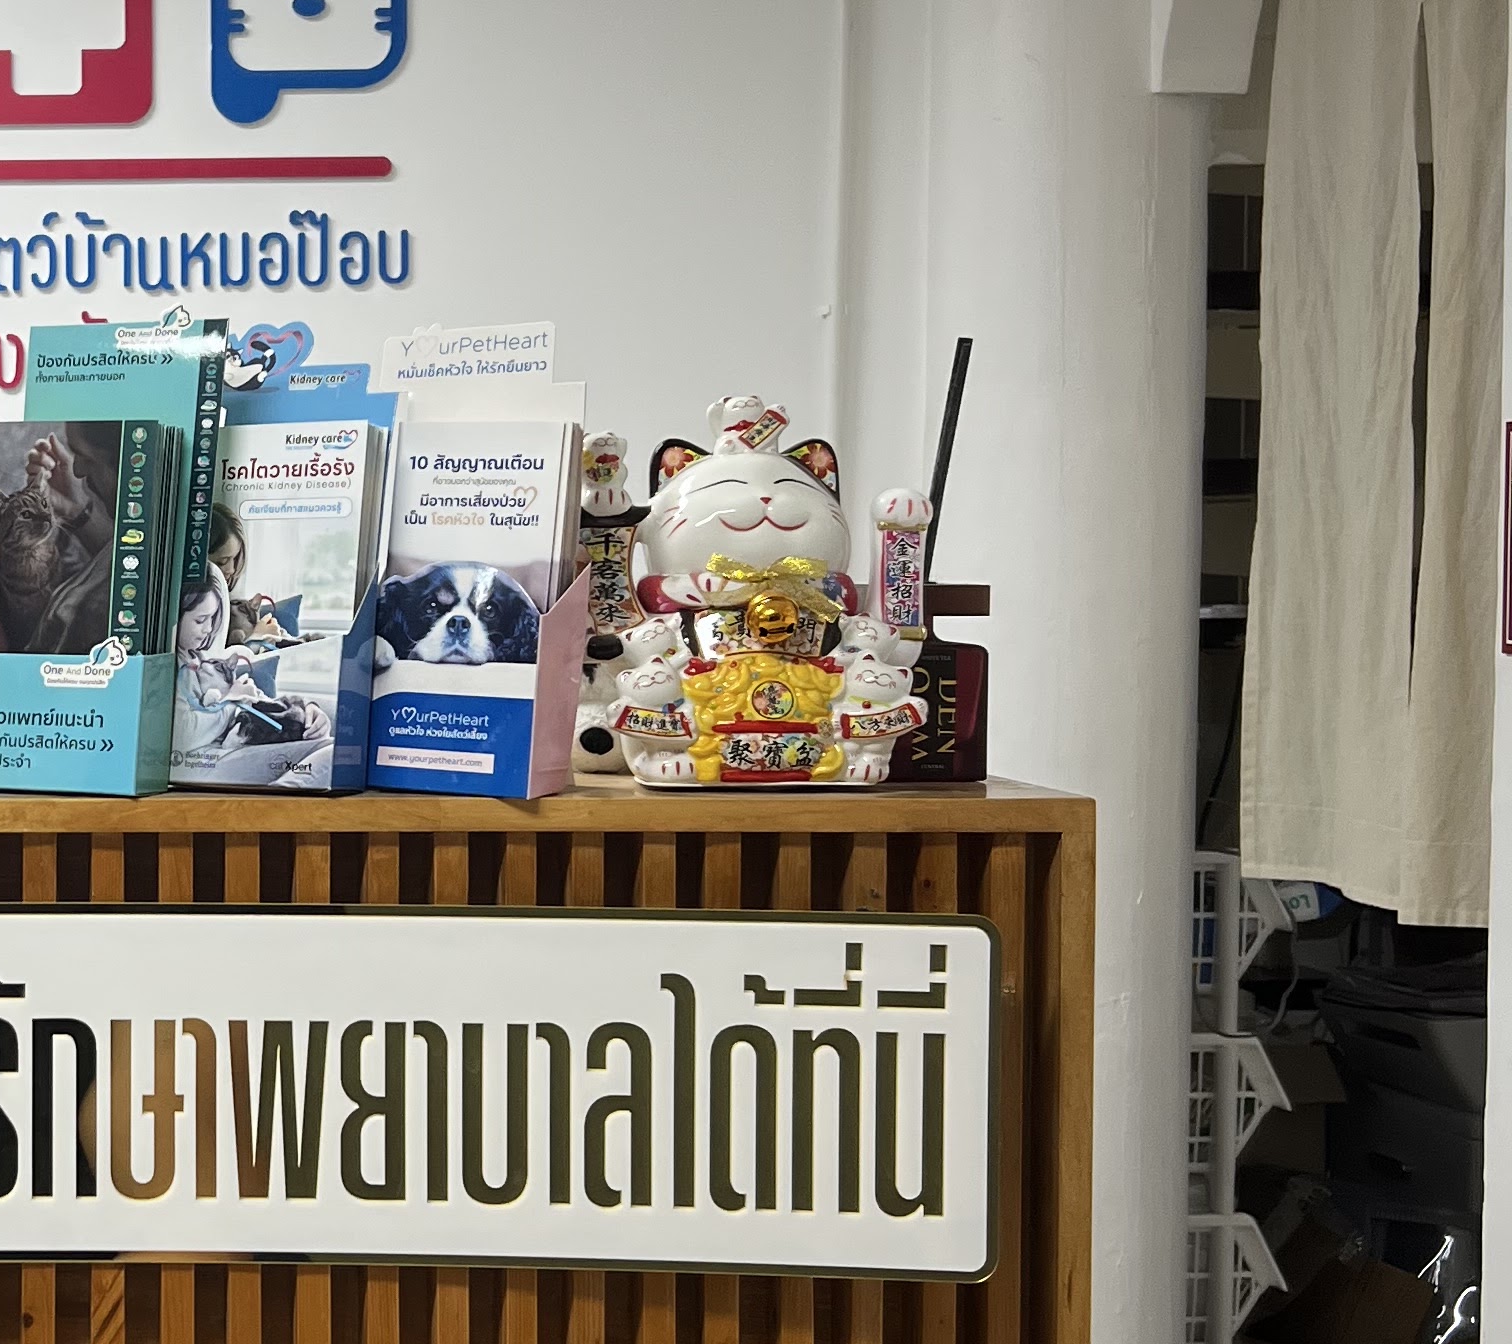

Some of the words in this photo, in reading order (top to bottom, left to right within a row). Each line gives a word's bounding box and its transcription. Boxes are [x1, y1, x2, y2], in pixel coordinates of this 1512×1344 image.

[117, 329, 136, 338] One
[154, 327, 179, 337] Done
[289, 374, 323, 386] Kidney
[325, 374, 346, 384] care
[285, 434, 319, 446] Kidney
[321, 434, 343, 444] care
[221, 451, 355, 481] โรคไตวายเรื้อรัง
[409, 455, 429, 470] 10
[433, 453, 544, 473] สัญญาณเตือน
[221, 482, 265, 493] (Chronic
[268, 481, 302, 492] Kidney
[305, 478, 352, 490] Disease)
[419, 490, 526, 508] มีอาการเสี่ยงป่วย
[404, 509, 427, 525] เป็น
[890, 536, 918, 625] 金運招財
[43, 664, 64, 675] One
[66, 667, 82, 676] And
[84, 665, 111, 677] Done
